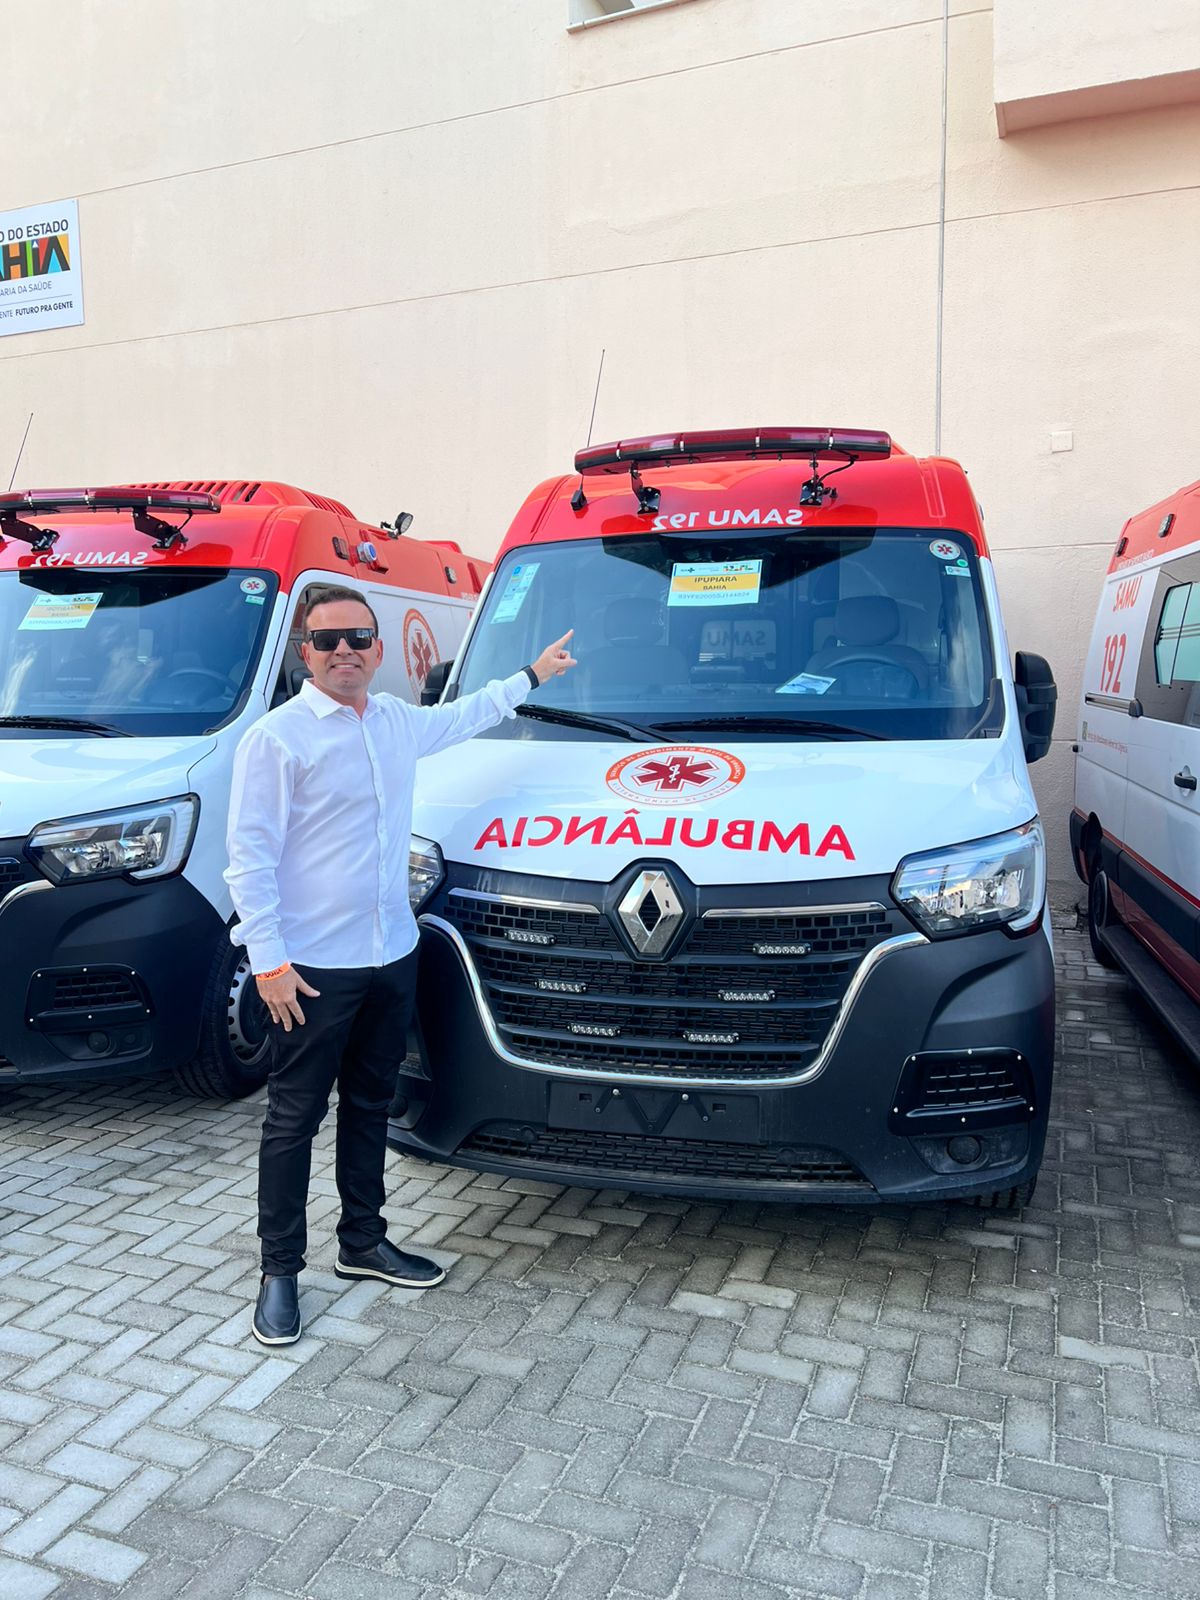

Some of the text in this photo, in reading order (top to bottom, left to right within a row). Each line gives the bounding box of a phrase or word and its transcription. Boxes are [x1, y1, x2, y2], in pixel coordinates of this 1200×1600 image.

[8, 227, 24, 241] DO
[26, 219, 69, 238] ESTADO
[17, 284, 28, 294] DA
[28, 281, 52, 293] SAÚDE
[15, 305, 40, 317] FUTURO
[40, 303, 52, 313] PRA
[53, 301, 73, 311] GENTE
[1112, 575, 1143, 612] SAMU
[1100, 633, 1127, 694] 192
